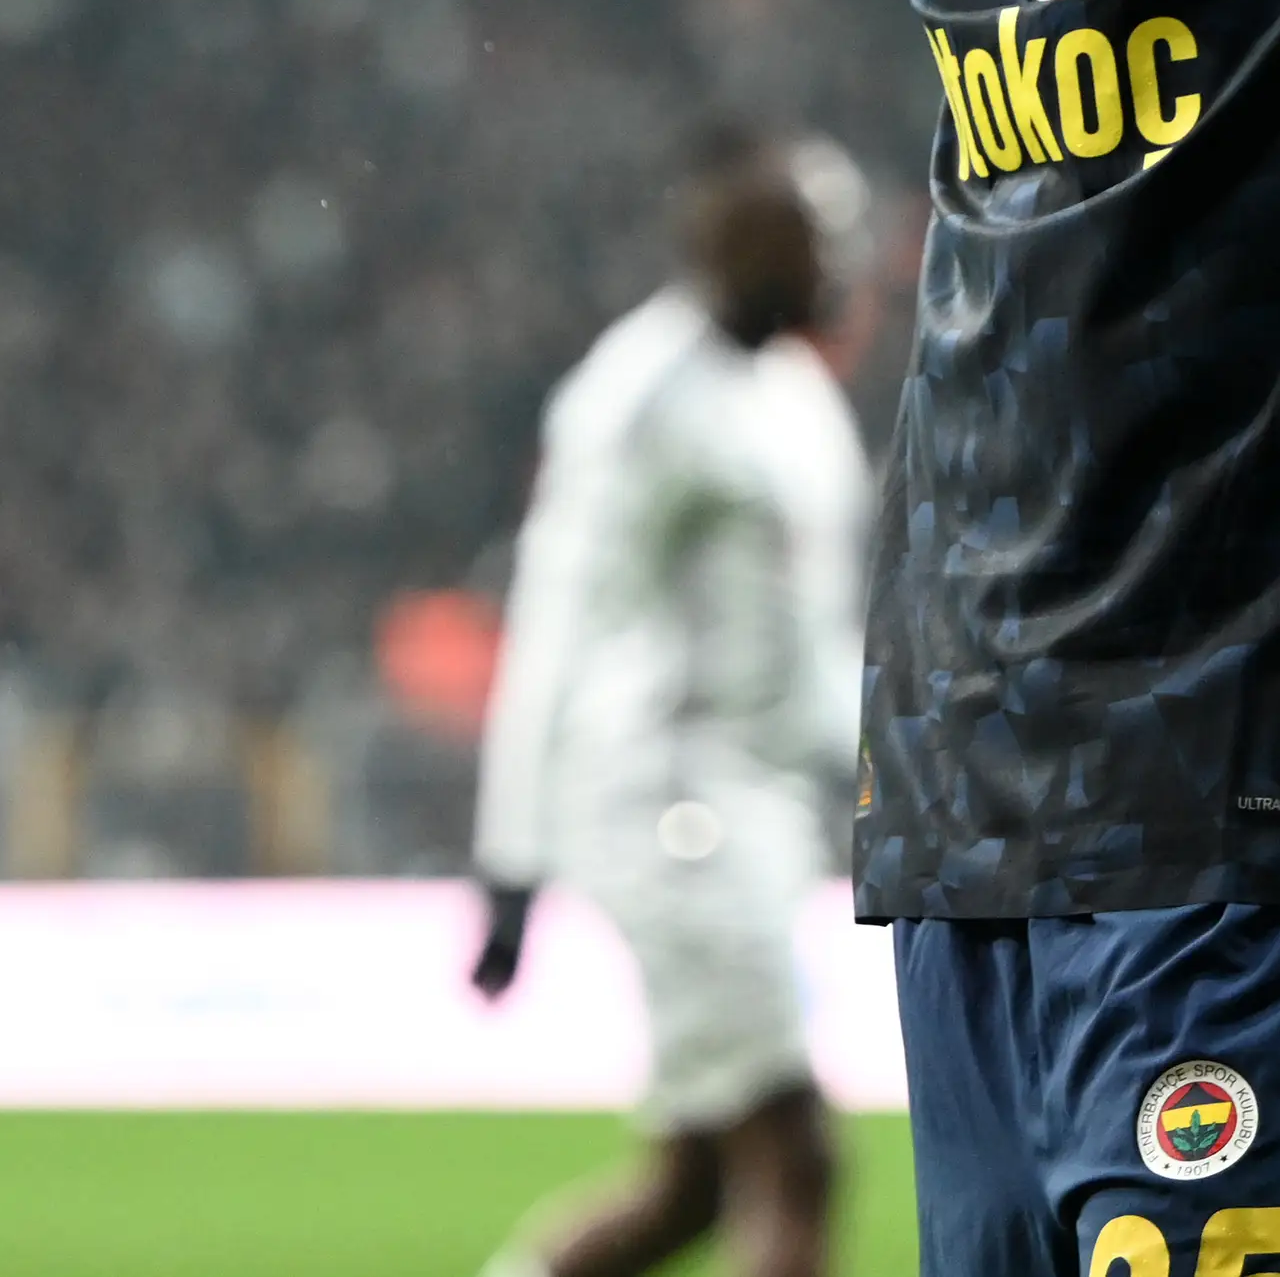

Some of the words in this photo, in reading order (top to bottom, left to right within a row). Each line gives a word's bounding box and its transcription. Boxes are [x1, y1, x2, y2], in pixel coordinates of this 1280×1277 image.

[923, 6, 1202, 182] tokoç
[1193, 1064, 1237, 1088] SPOR
[1176, 1161, 1211, 1177] 1907
